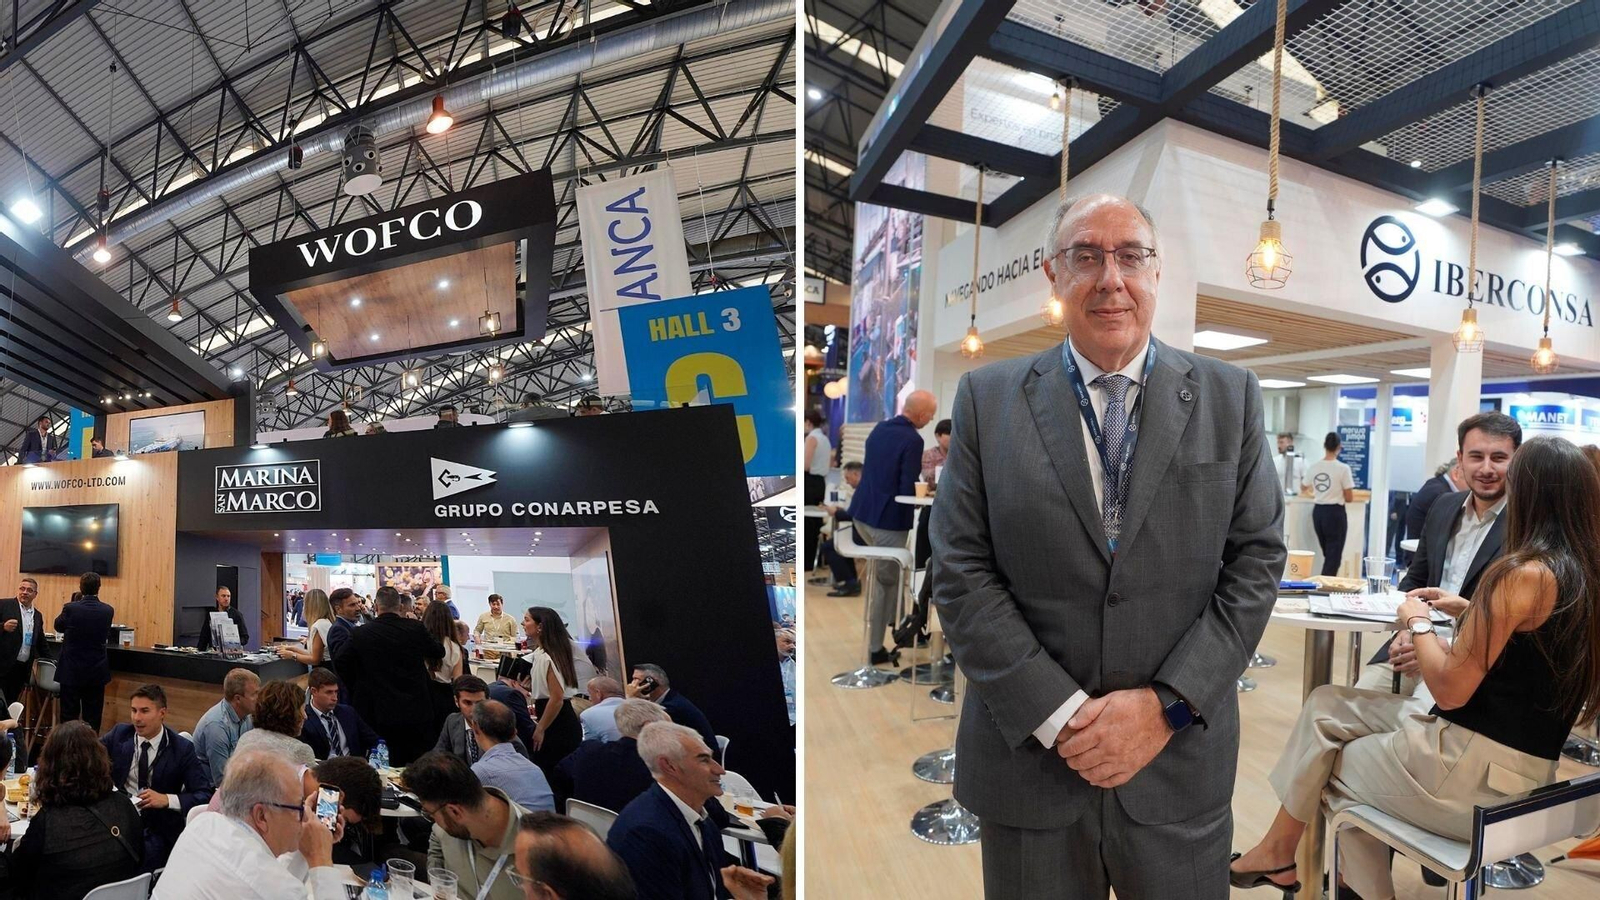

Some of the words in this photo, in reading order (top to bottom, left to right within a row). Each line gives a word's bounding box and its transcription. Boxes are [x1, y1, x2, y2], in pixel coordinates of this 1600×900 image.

[296, 200, 483, 268] WOFCO
[996, 254, 1030, 287] HACIA
[1433, 259, 1594, 328] IBERCONSA
[648, 311, 715, 342] HALL
[720, 307, 742, 332] 3
[31, 475, 126, 491] WWW.WOFCO-LTD.COM
[220, 466, 315, 488] MARINA
[217, 493, 226, 513] SAN
[226, 490, 317, 511] MARCO
[434, 503, 503, 518] GRUPO
[511, 500, 660, 516] CONARPESA
